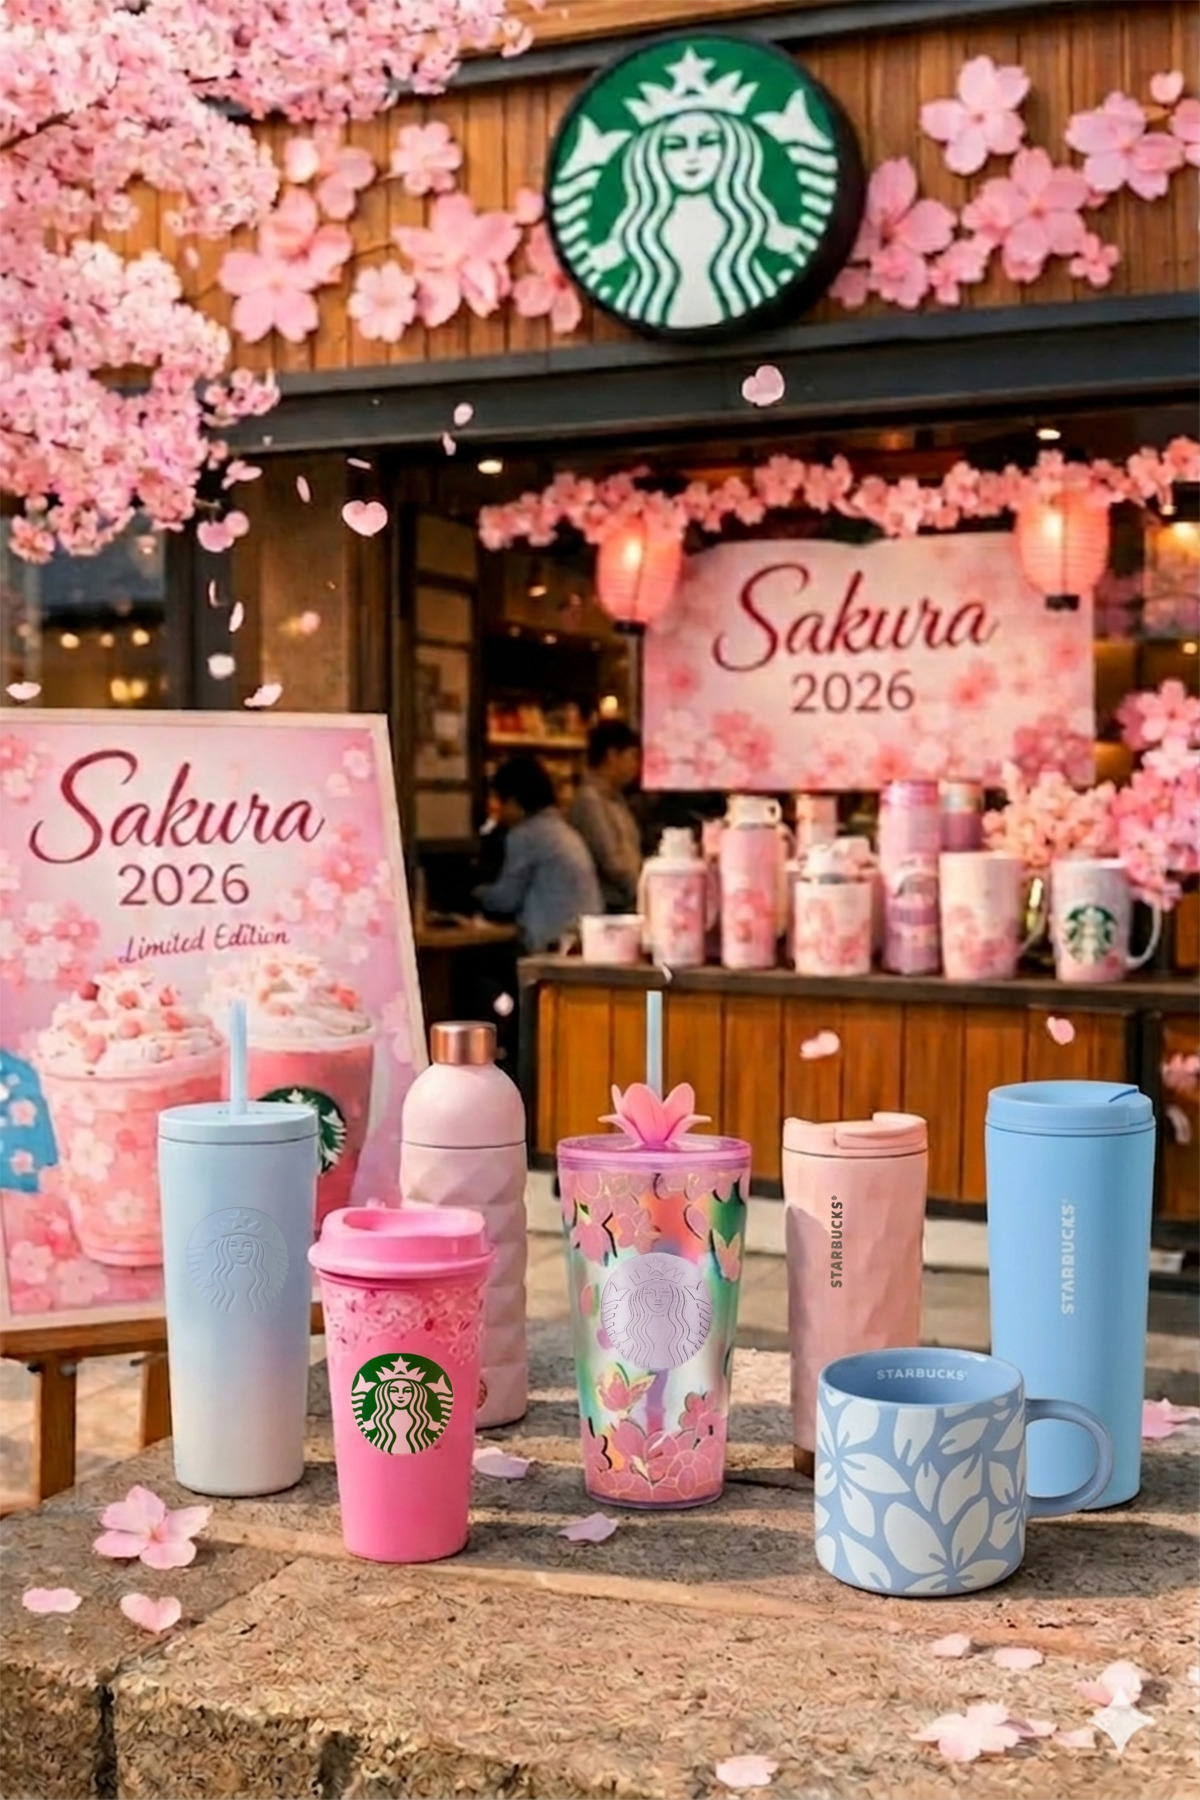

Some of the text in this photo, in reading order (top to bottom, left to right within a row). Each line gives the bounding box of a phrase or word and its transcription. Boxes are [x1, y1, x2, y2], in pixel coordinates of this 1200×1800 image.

[712, 562, 999, 672] Sakura
[791, 669, 915, 714] 2026
[29, 749, 325, 864] Sakura
[118, 863, 250, 906] 2026
[118, 923, 290, 964] Limited Edition
[1061, 1203, 1075, 1315] STARBUCKS
[876, 1367, 965, 1381] STARBUCKS
